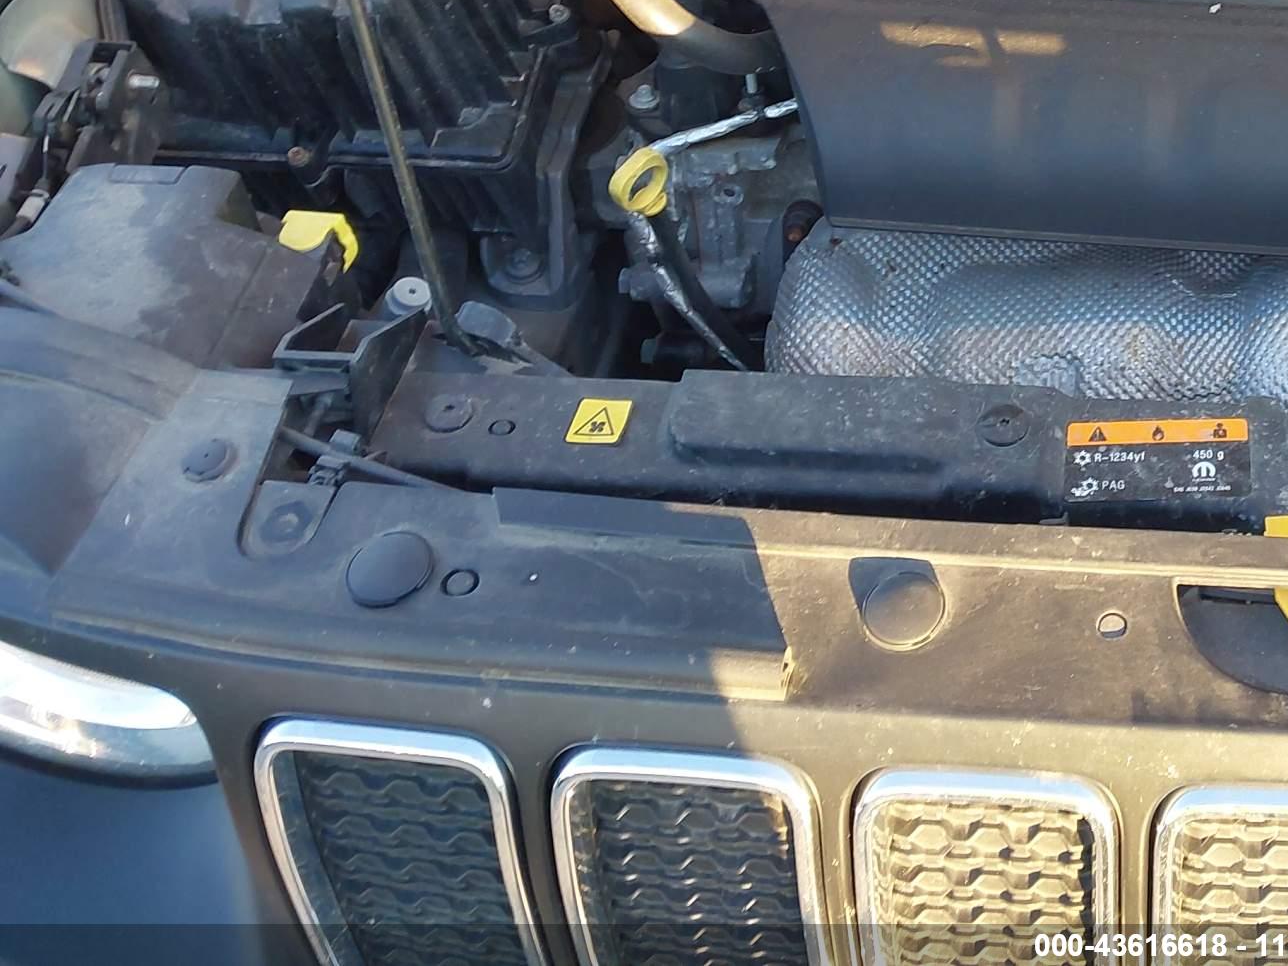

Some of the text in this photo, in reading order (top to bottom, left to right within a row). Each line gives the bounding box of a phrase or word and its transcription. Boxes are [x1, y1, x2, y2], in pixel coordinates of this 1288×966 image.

[1193, 449, 1225, 461] 450 g
[1102, 480, 1125, 490] PAG
